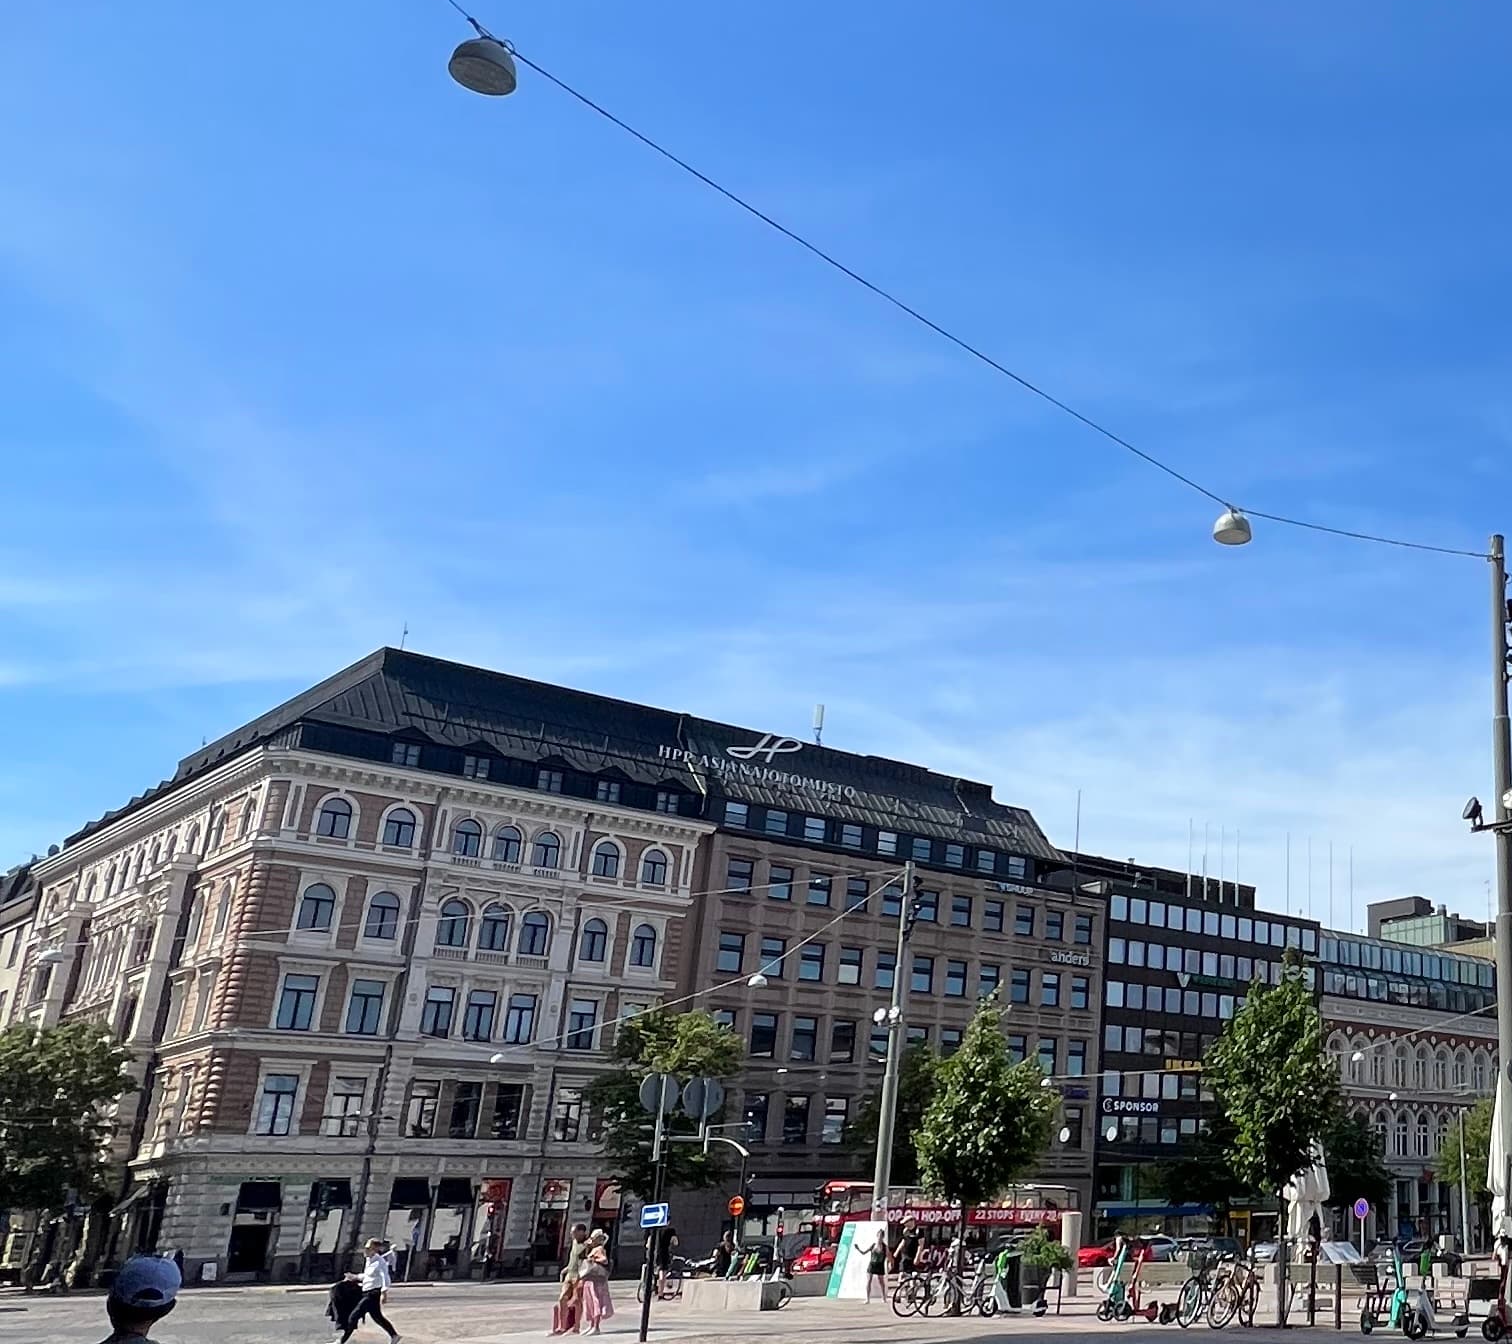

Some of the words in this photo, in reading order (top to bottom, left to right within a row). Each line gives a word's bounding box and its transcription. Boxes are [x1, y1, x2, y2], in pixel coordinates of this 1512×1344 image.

[1165, 1058, 1202, 1072] IKEA
[1113, 1100, 1159, 1113] SPONSOR
[987, 1209, 1015, 1221] STOPS
